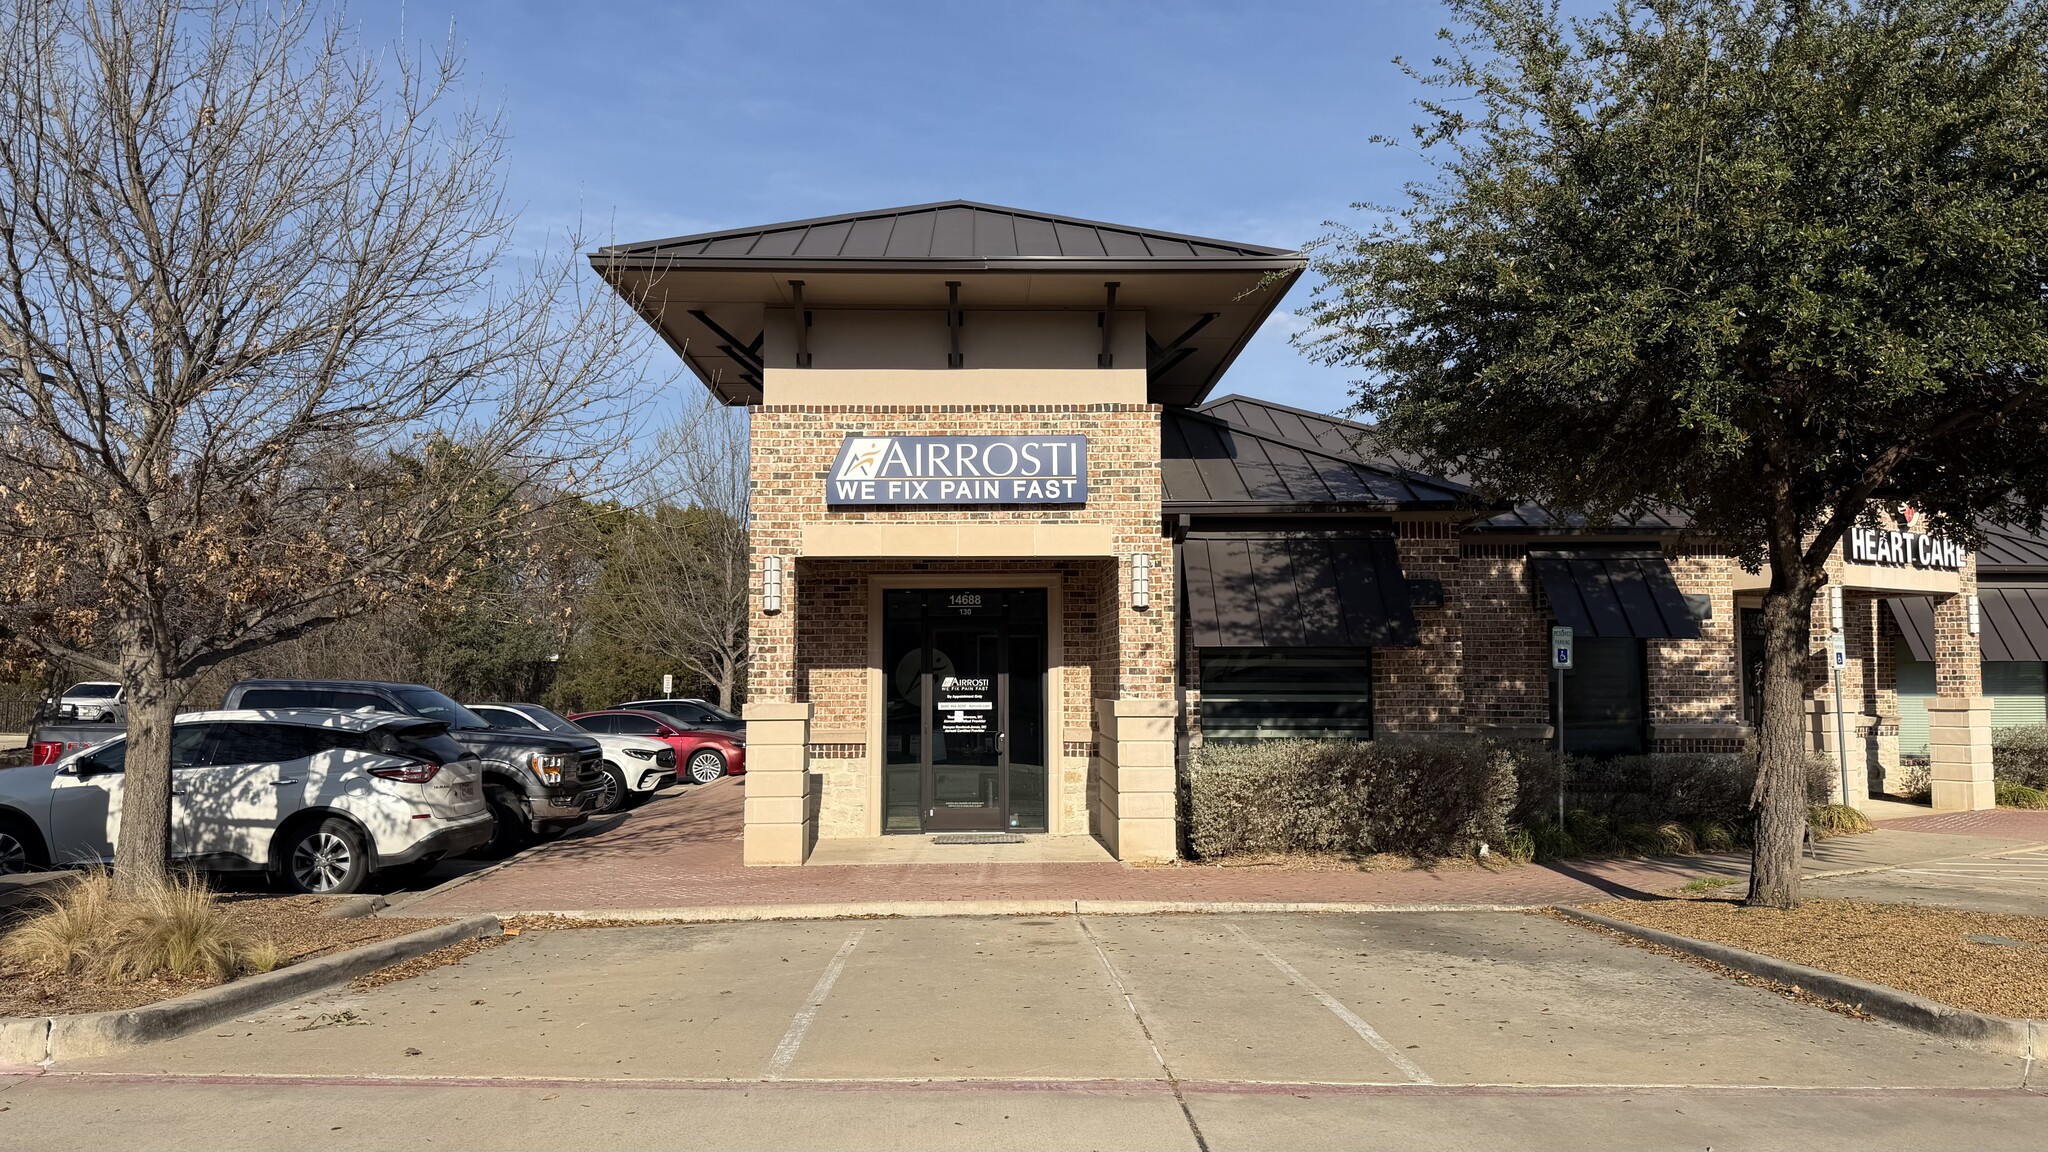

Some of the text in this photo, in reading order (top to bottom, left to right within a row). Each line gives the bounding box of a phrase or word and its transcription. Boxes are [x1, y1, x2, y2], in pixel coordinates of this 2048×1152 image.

[881, 440, 1077, 477] AIRROSTI
[836, 479, 1078, 500] WE FIX PAIN FAST
[1851, 527, 1967, 567] HEART CARE
[950, 594, 981, 605] 14688
[952, 677, 988, 686] AIRROSTI
[67, 741, 96, 750] FX
